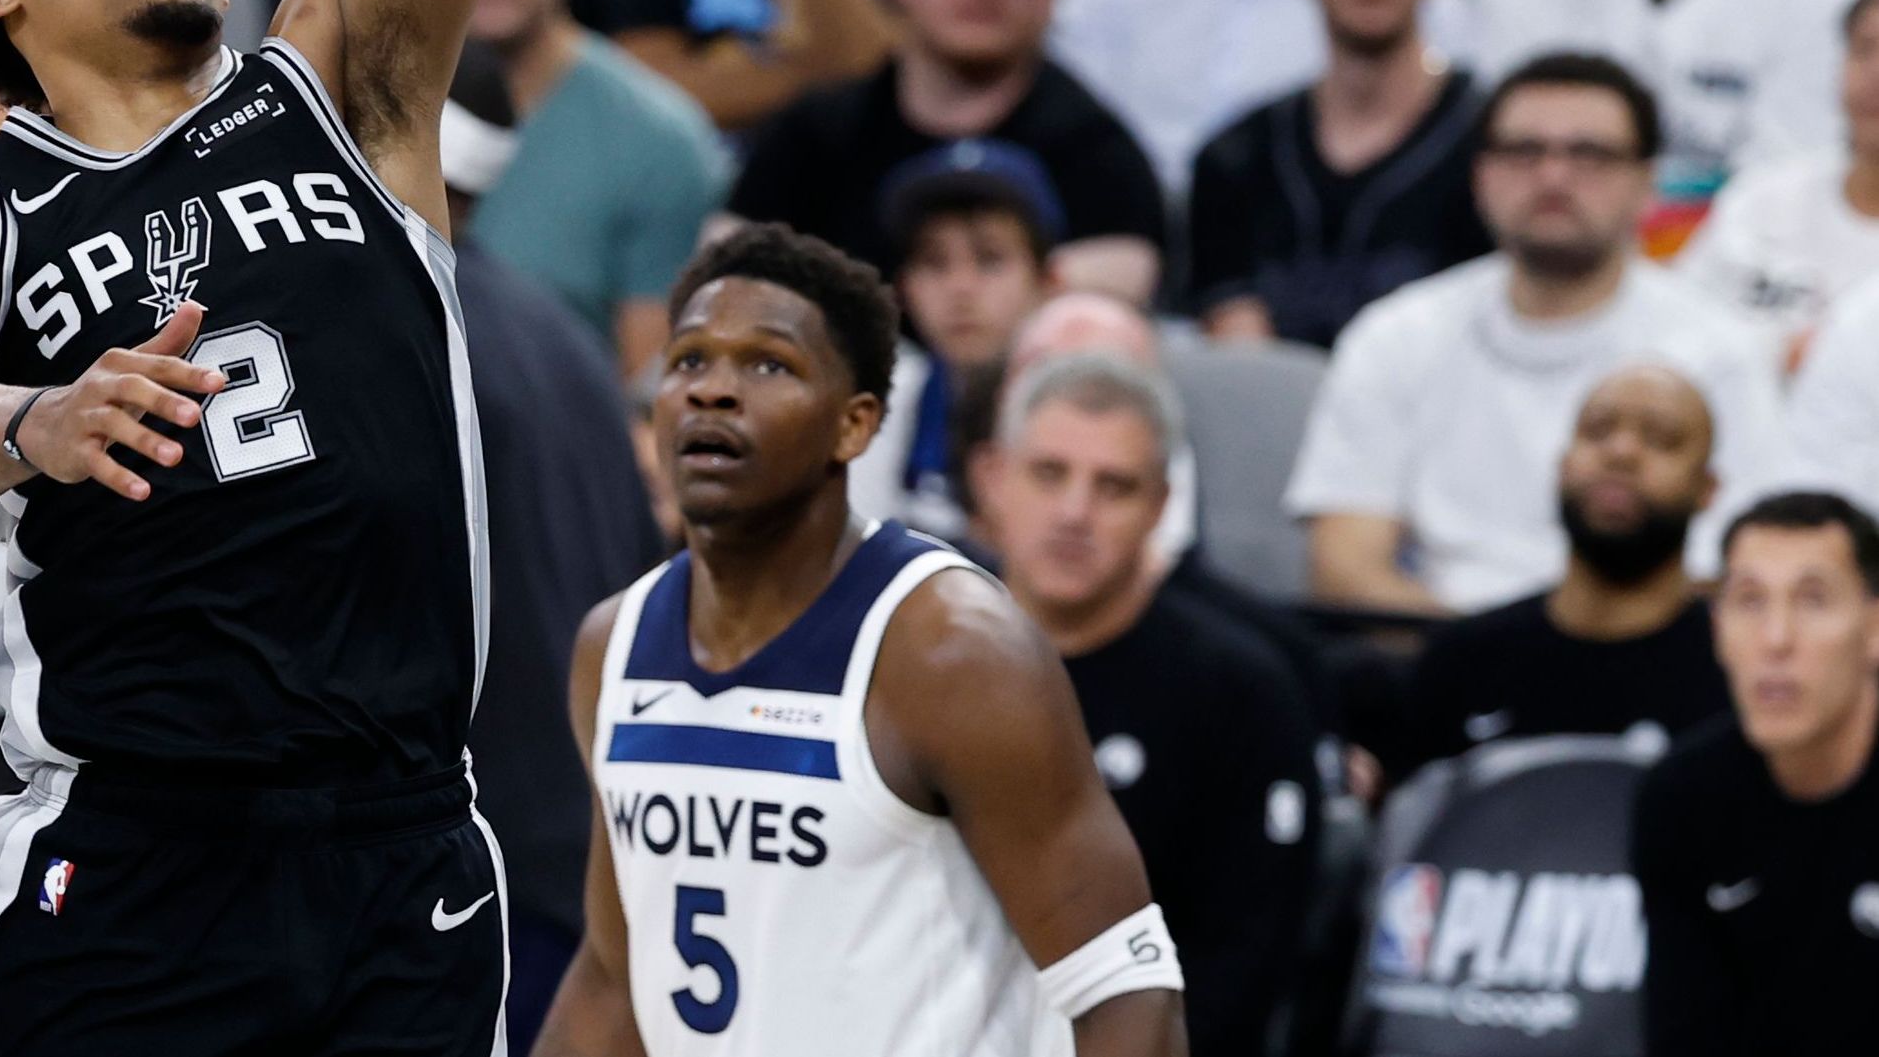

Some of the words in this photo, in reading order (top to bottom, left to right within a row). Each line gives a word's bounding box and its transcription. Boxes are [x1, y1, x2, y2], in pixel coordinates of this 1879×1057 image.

[198, 97, 270, 145] LEDGER
[16, 172, 365, 360] SPURS
[184, 319, 316, 483] 2
[762, 703, 824, 725] sezzle
[606, 791, 828, 868] WOLVES
[670, 884, 740, 1035] 5
[1128, 928, 1161, 964] 5
